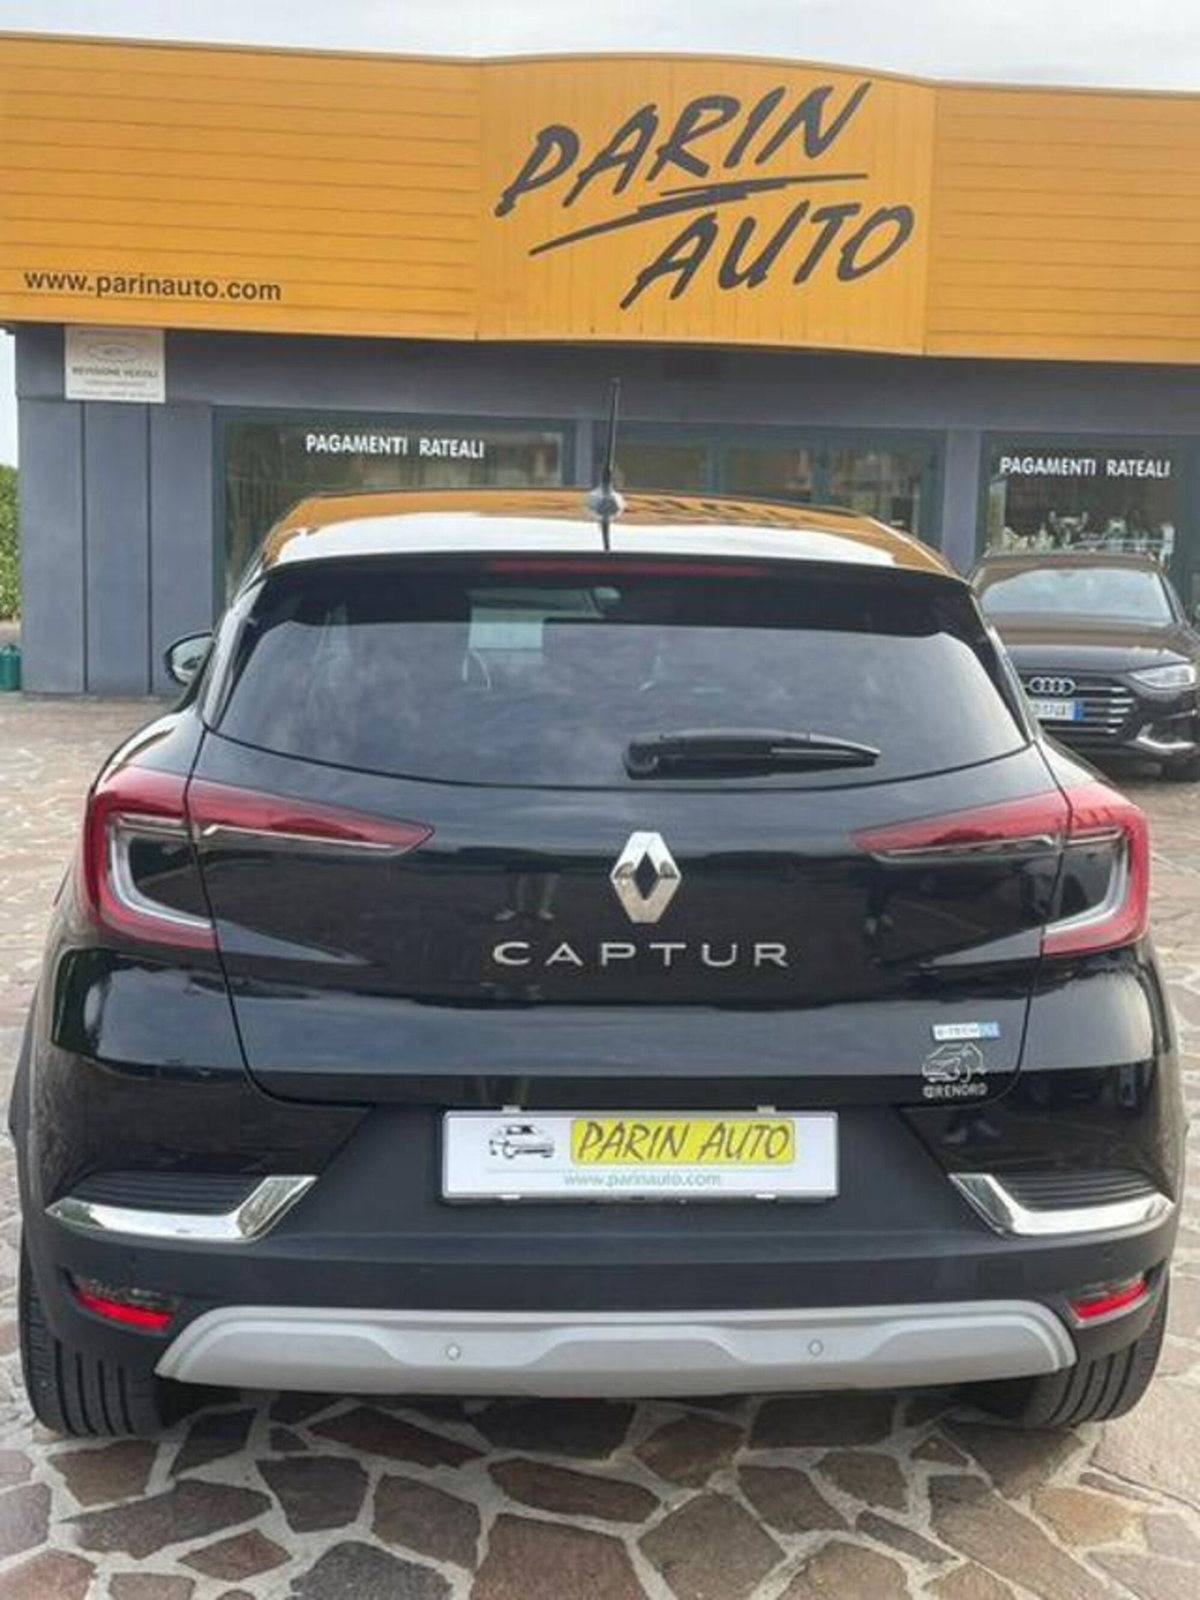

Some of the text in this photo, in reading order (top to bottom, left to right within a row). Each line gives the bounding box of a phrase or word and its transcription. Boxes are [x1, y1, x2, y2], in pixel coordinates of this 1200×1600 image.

[494, 81, 872, 218] PARIN
[619, 200, 915, 310] AUTO
[24, 269, 281, 301] www.parinauto.com
[305, 434, 485, 459] PAGAMENTI RATEALI
[1000, 456, 1171, 478] PAGAMENTI RATEALI
[492, 941, 789, 968] CAPTUR
[577, 1119, 791, 1162] PARIN AUTO
[564, 1172, 722, 1188] www.parinauto.com
